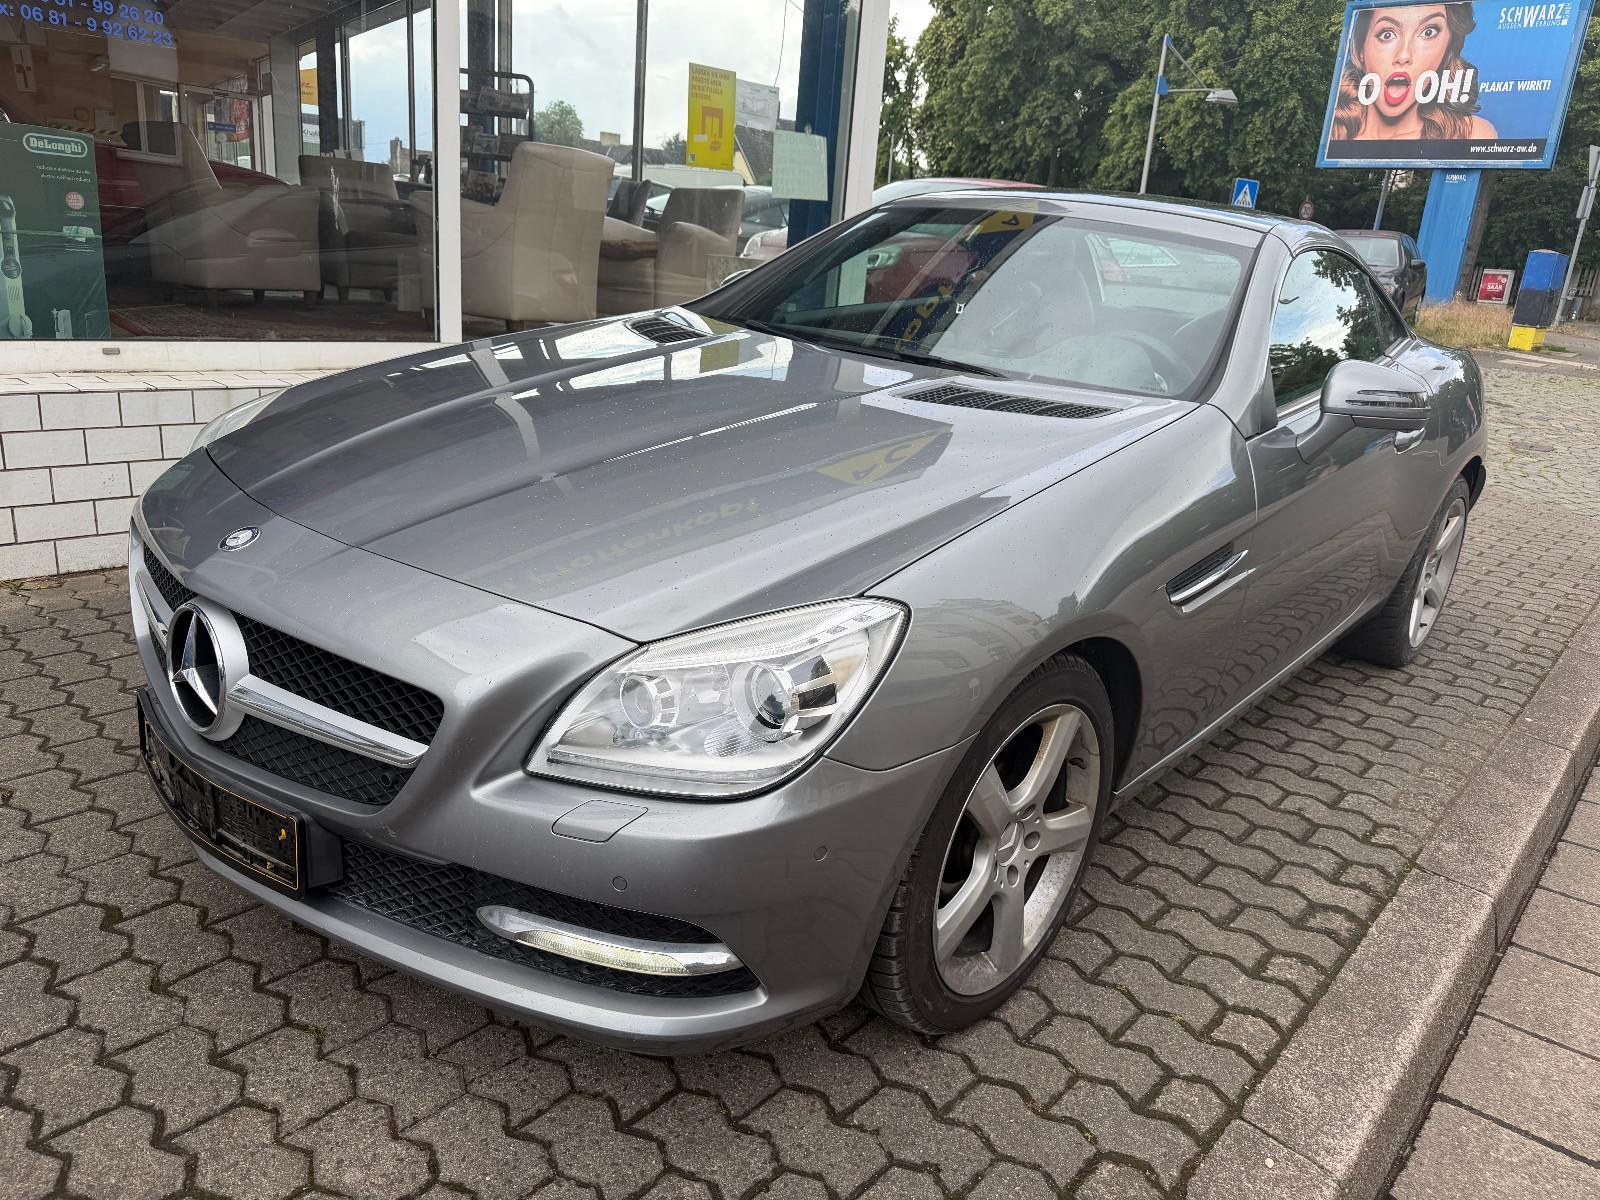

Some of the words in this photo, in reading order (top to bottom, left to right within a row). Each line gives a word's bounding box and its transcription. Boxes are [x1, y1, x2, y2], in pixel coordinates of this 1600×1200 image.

[92, 0, 113, 15] 99
[118, 3, 140, 20] 26
[144, 9, 164, 24] 20
[1500, 4, 1564, 28] SCHWARZ
[20, 4, 44, 21] 06
[49, 10, 67, 26] 81
[86, 17, 97, 32] 9
[102, 20, 123, 38] 92
[128, 25, 148, 42] 62
[152, 30, 173, 46] 23
[1357, 72, 1381, 105] O
[1414, 69, 1474, 104] OH!
[1479, 81, 1515, 93] PLAKAT
[1517, 80, 1552, 91] WIRKT!
[1470, 143, 1537, 153] www.schwarz-aw.de
